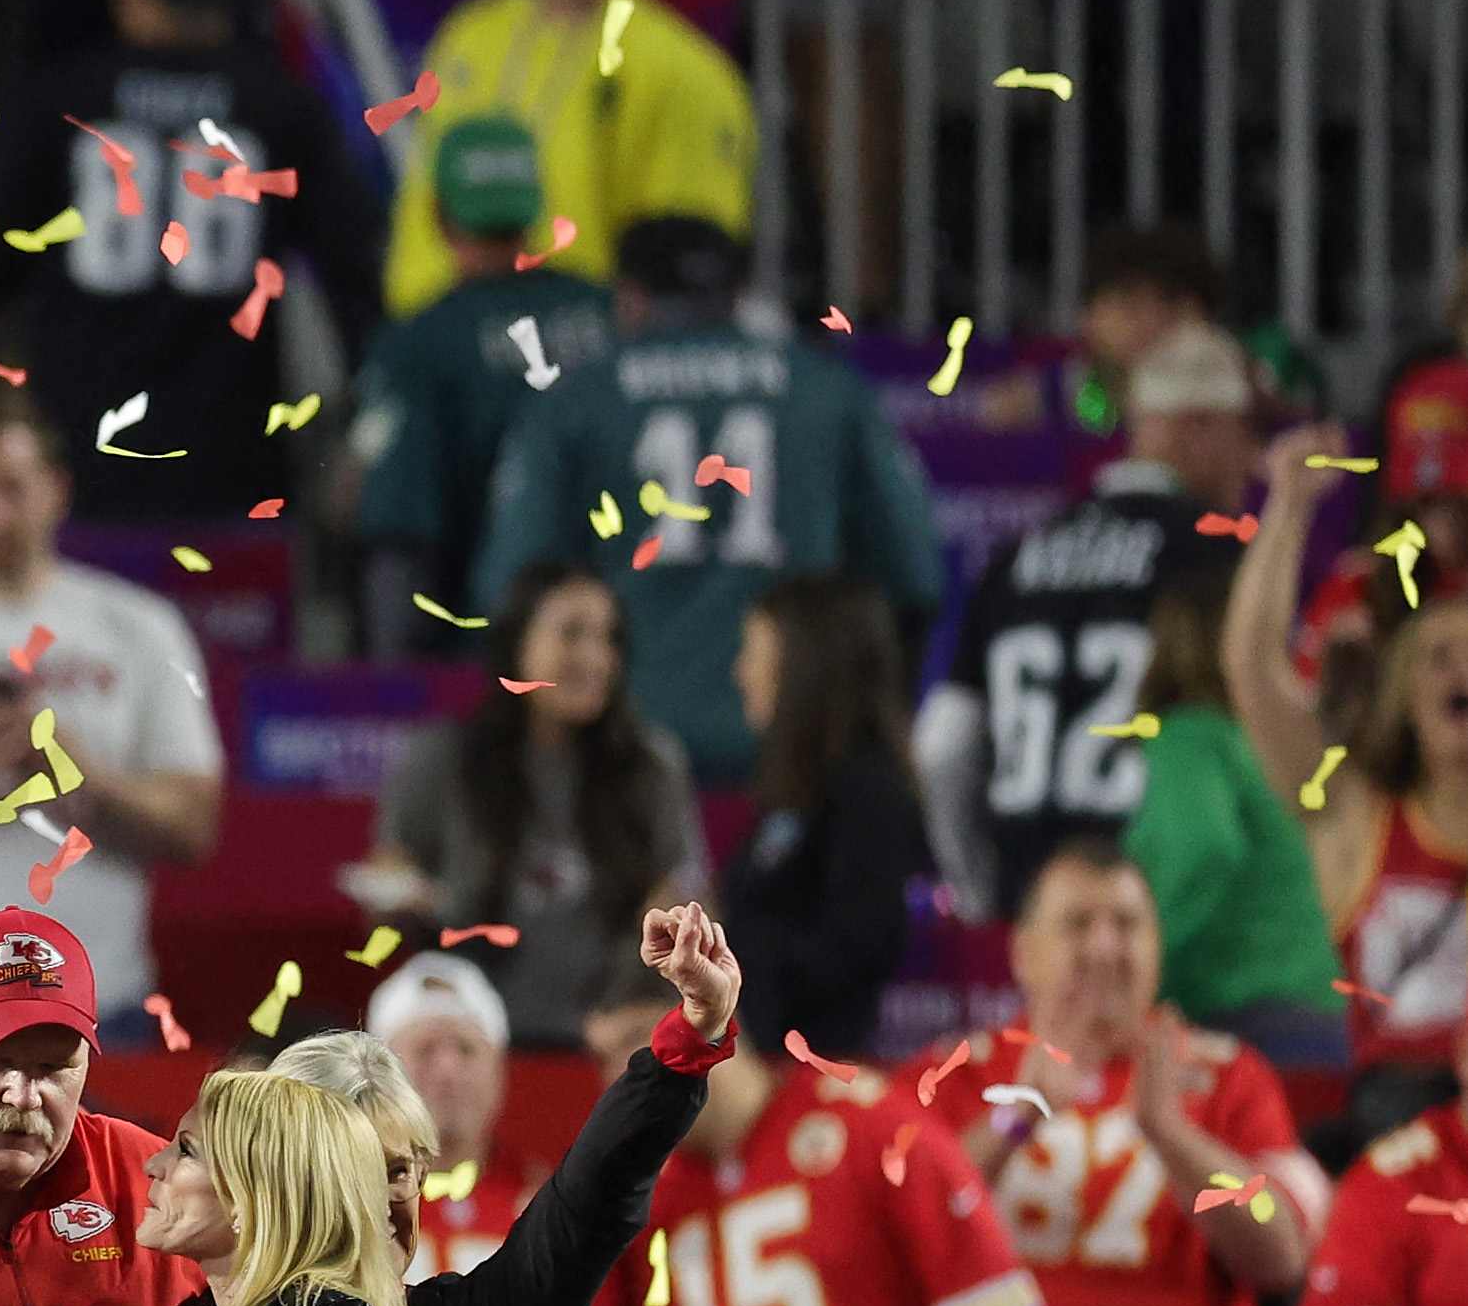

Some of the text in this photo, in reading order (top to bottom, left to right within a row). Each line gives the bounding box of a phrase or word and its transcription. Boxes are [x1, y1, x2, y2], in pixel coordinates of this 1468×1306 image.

[632, 407, 786, 567] 11
[986, 621, 1156, 815] 62
[12, 940, 53, 964] KC
[63, 1206, 102, 1229] KC
[992, 1107, 1172, 1268] 87
[72, 1246, 123, 1263] CHIEFS
